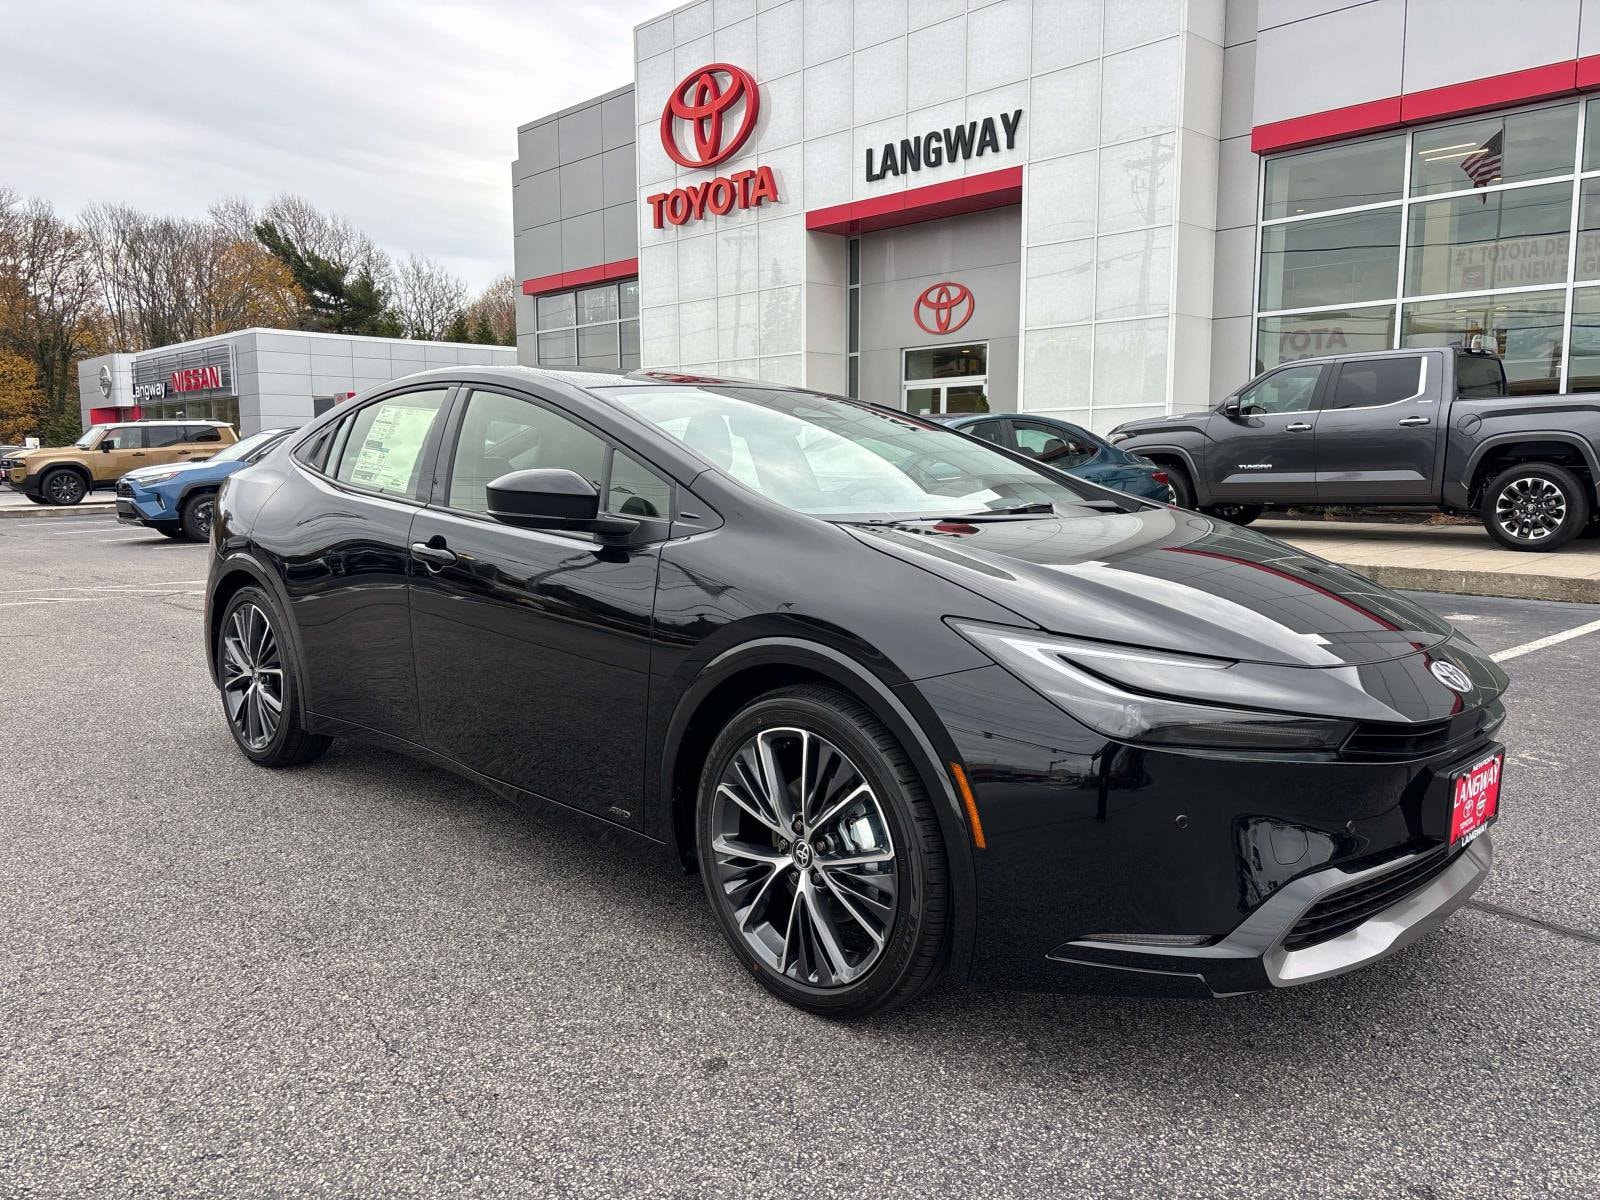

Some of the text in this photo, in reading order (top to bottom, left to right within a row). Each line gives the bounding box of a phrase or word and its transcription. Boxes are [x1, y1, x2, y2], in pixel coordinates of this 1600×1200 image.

[865, 108, 1023, 183] LANGWAY
[647, 165, 779, 229] TOYOTA
[1480, 240, 1538, 262] TOYOTA
[1496, 262, 1514, 281] IN
[1520, 260, 1556, 280] NEW
[132, 382, 167, 400] Langway
[172, 366, 222, 393] NISSAN
[1454, 764, 1500, 808] LANGWAY
[1461, 821, 1488, 847] LANGWAY
